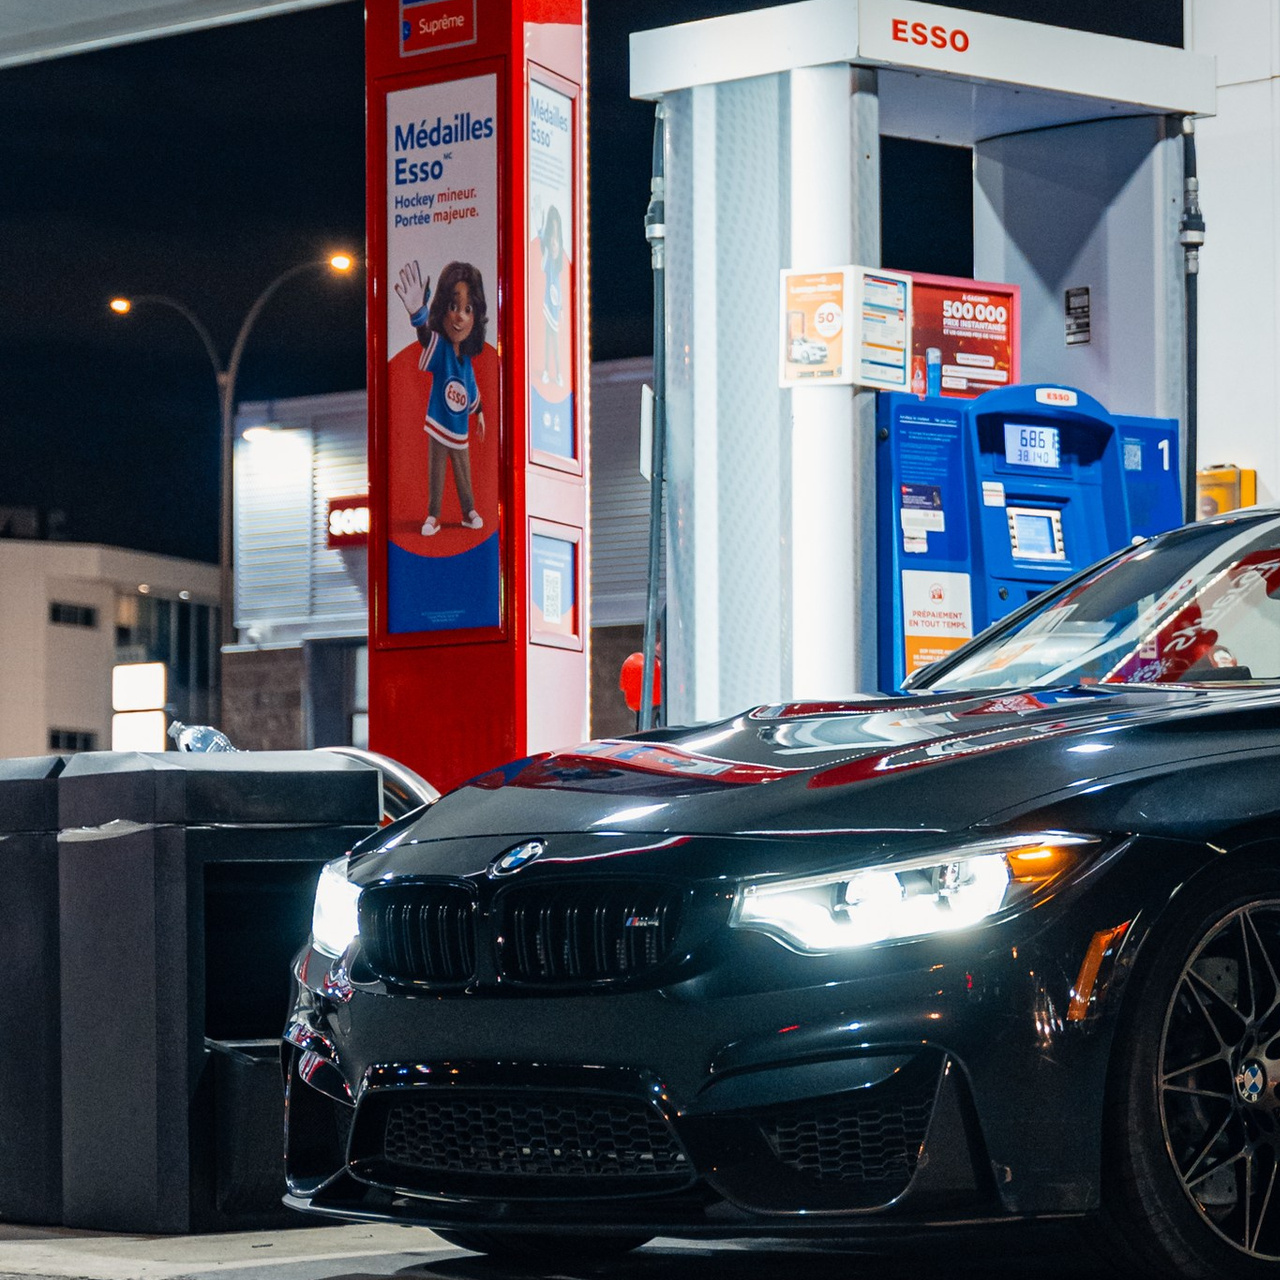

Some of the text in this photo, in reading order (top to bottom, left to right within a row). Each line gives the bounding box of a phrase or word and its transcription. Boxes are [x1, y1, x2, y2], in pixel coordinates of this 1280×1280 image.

[418, 13, 465, 36] Suprême
[892, 18, 970, 53] ESSO
[394, 112, 493, 152] Médailles
[531, 121, 551, 148] Esso
[394, 157, 444, 186] Esso
[394, 186, 477, 209] Hockey mineur.
[394, 205, 479, 228] Portée majeure.
[943, 300, 1007, 323] 500 000
[1047, 392, 1070, 402] ESSO
[1158, 439, 1169, 471] 1
[909, 619, 919, 627] EN
[921, 620, 940, 628] TOUT
[912, 610, 963, 619] PRÉPAIEMENT
